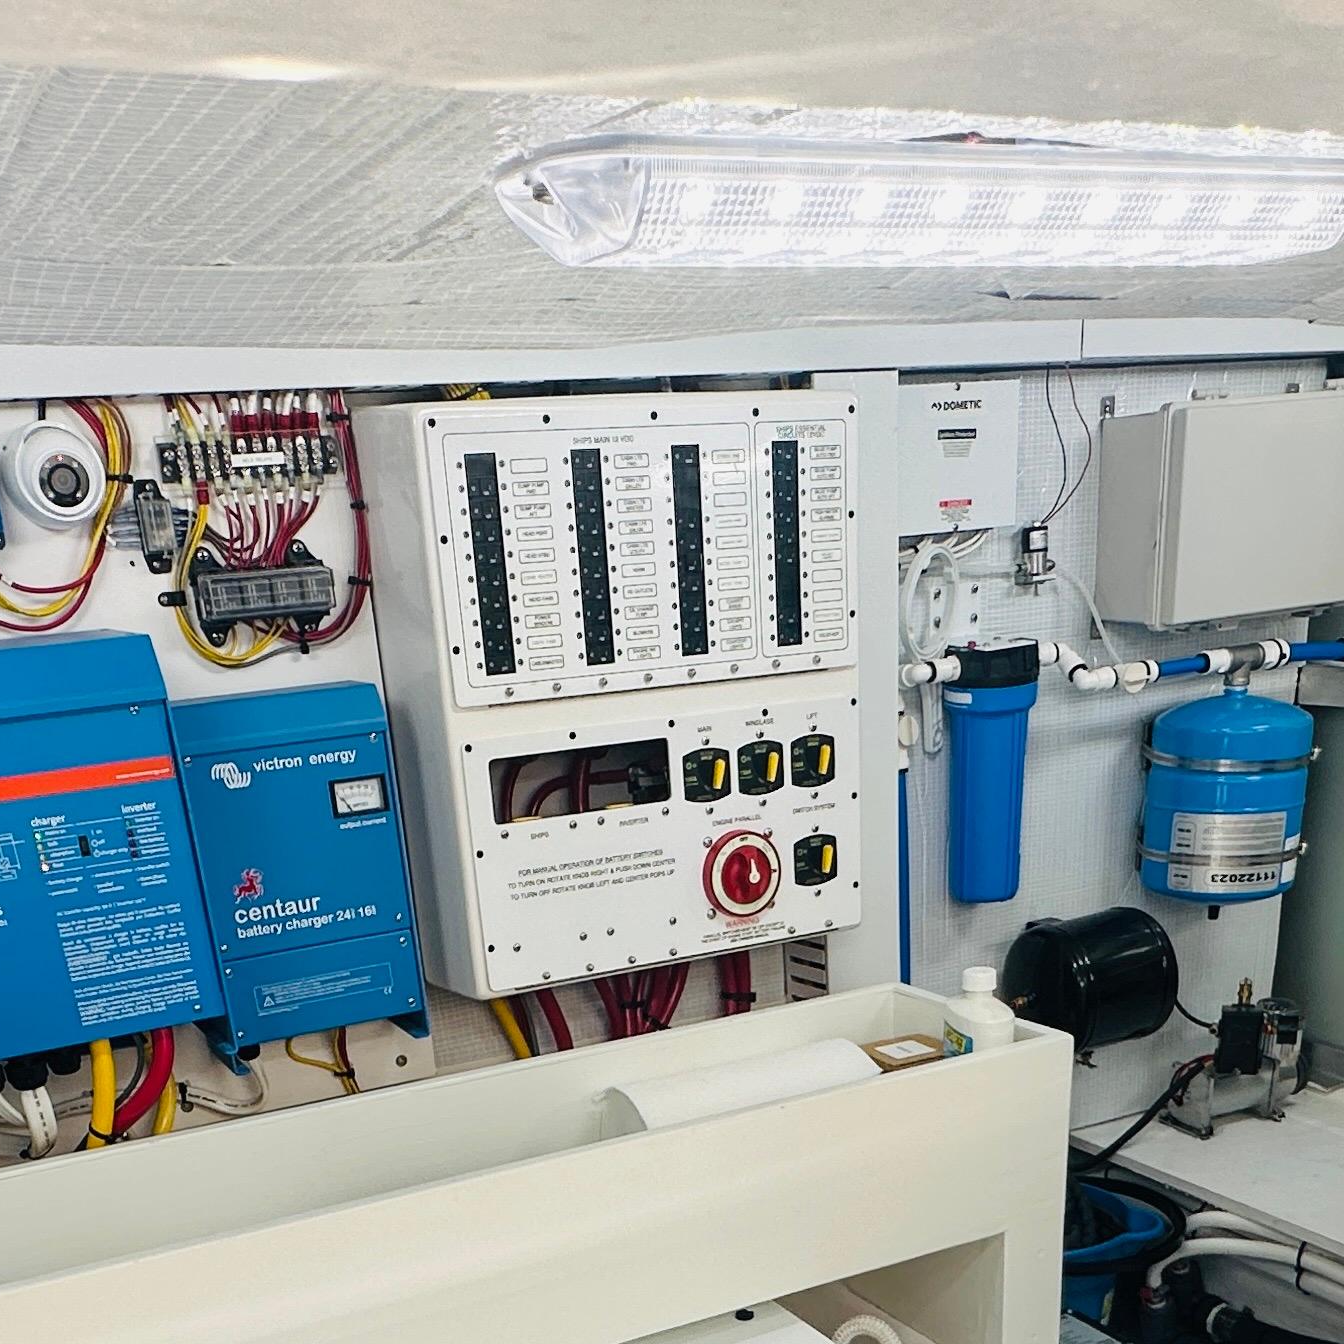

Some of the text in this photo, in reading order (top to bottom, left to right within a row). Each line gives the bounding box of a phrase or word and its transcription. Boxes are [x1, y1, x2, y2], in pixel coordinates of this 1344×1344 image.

[943, 399, 983, 411] DOMETIC
[253, 749, 356, 773] victron energy
[30, 814, 66, 827] charger
[508, 882, 517, 890] TO
[518, 880, 535, 889] TURN
[536, 878, 546, 886] ON
[547, 874, 572, 884] ROTATE
[633, 862, 652, 871] DOWN
[653, 857, 676, 867] CENTER
[518, 868, 532, 877] FOR
[559, 859, 594, 871] OPERATION
[595, 857, 603, 865] OF
[605, 853, 632, 864] BATTERY
[1210, 869, 1277, 884] 11122023
[511, 893, 520, 901] TO
[521, 890, 538, 900] TURN
[539, 889, 551, 897] OFF
[552, 884, 577, 895] ROTATE
[596, 879, 611, 888] LEFT
[625, 873, 650, 883] CENTER
[666, 868, 676, 877] UP
[234, 896, 321, 925] centaur
[237, 922, 283, 940] battery
[285, 914, 333, 932] charger
